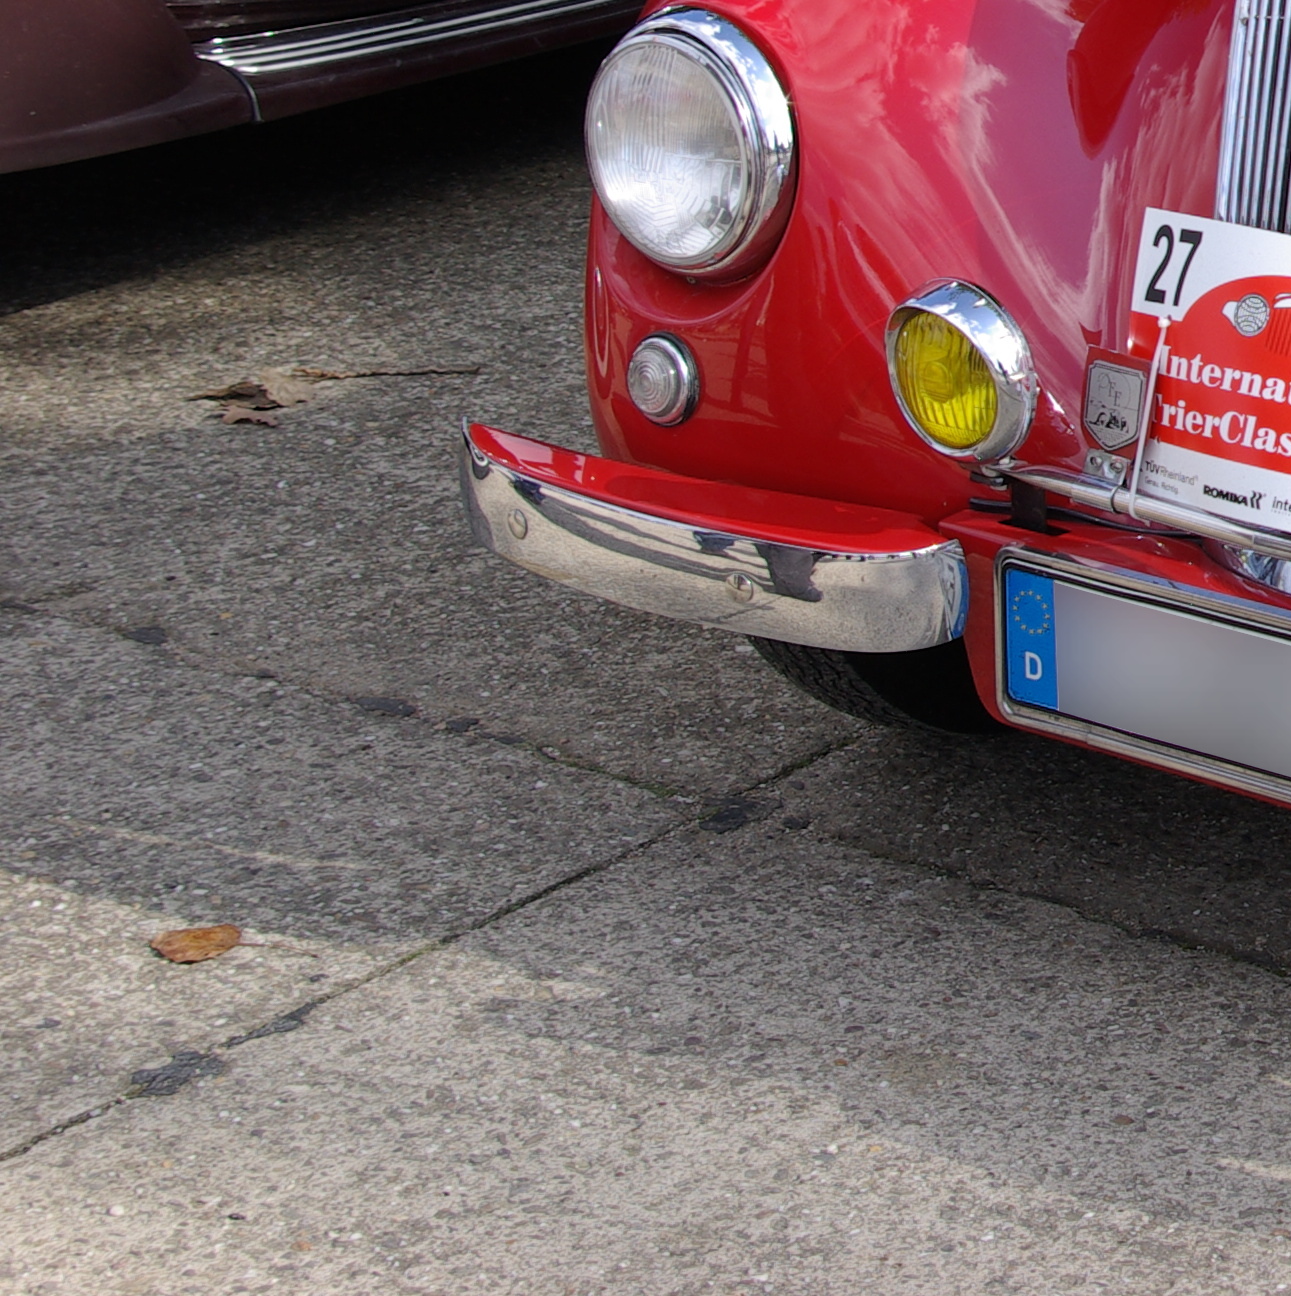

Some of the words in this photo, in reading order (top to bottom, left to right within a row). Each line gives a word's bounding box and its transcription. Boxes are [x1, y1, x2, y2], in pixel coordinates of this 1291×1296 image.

[1144, 224, 1203, 307] 27
[1203, 484, 1249, 508] ROMIKA
[1024, 650, 1043, 681] D
